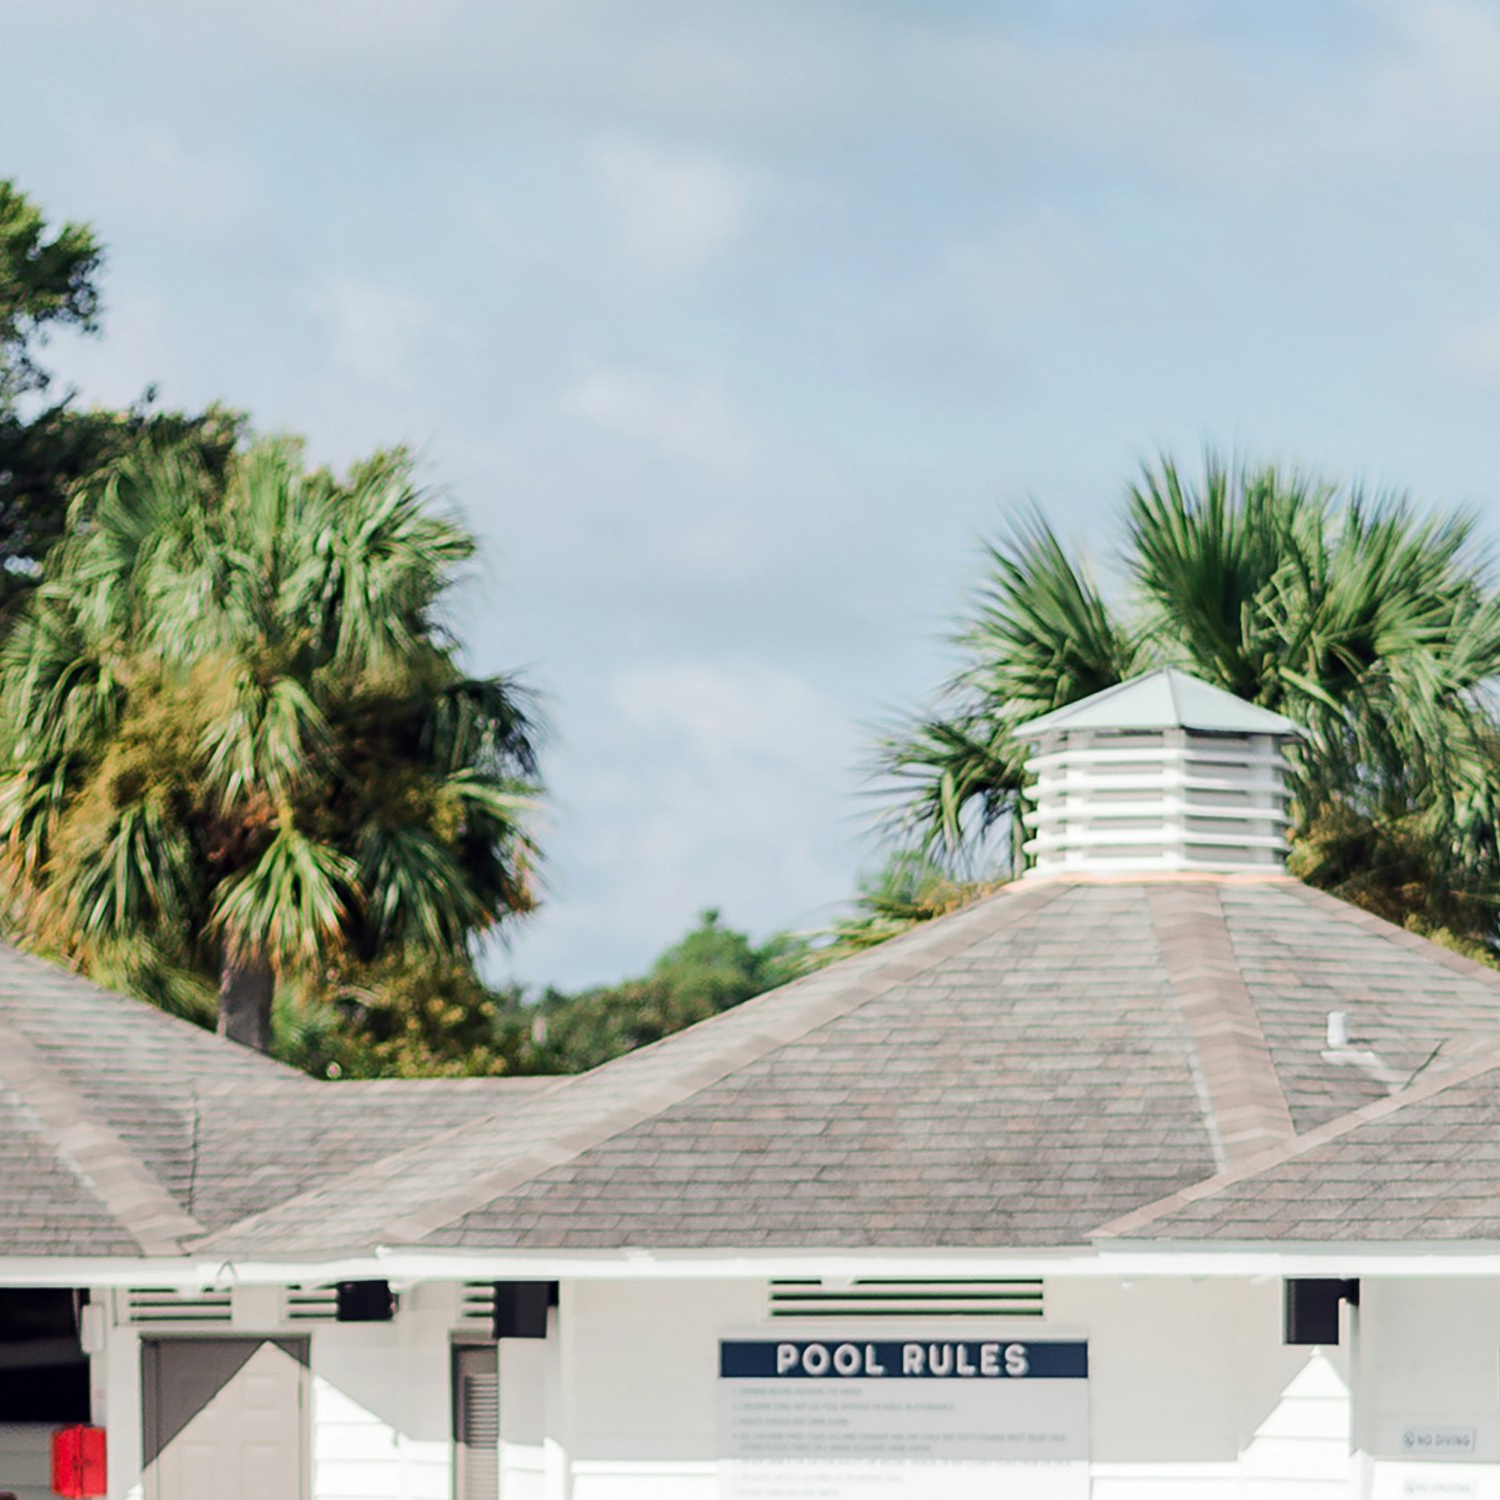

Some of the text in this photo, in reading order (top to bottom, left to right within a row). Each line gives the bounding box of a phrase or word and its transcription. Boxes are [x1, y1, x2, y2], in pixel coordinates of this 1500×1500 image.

[777, 1344, 1030, 1376] POOL RULES
[1417, 1433, 1471, 1447] NO DIVING
